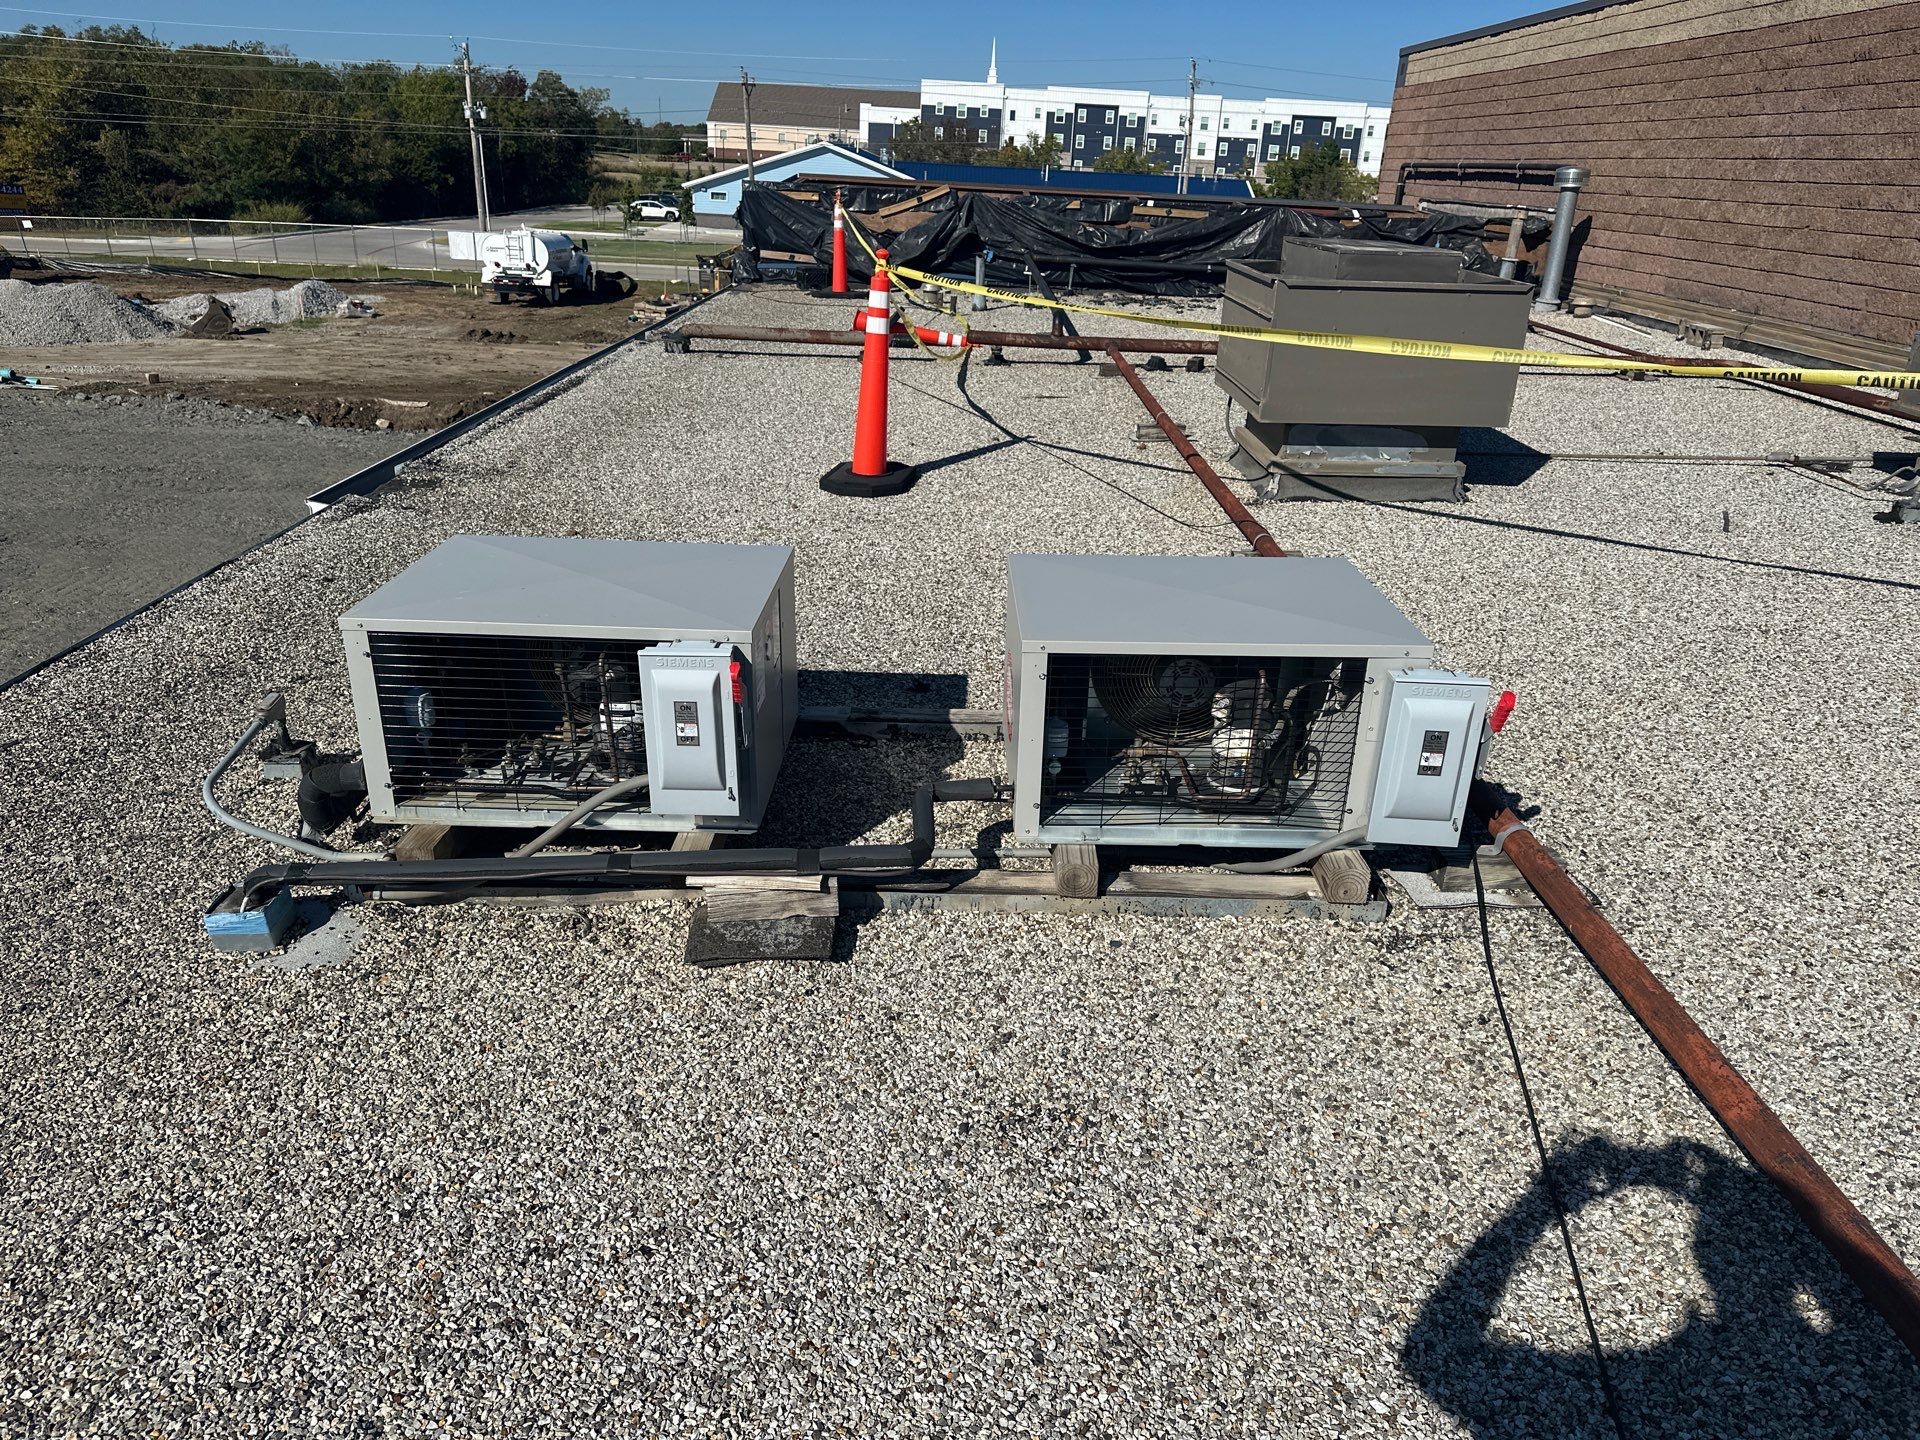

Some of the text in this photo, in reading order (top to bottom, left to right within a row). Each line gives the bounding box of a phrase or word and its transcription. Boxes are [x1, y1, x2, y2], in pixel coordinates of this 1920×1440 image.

[921, 272, 962, 287] CAUTION
[656, 657, 715, 669] SIEMENS
[1411, 686, 1472, 699] SIEMENS
[679, 704, 692, 712] ON
[680, 735, 696, 743] OFF
